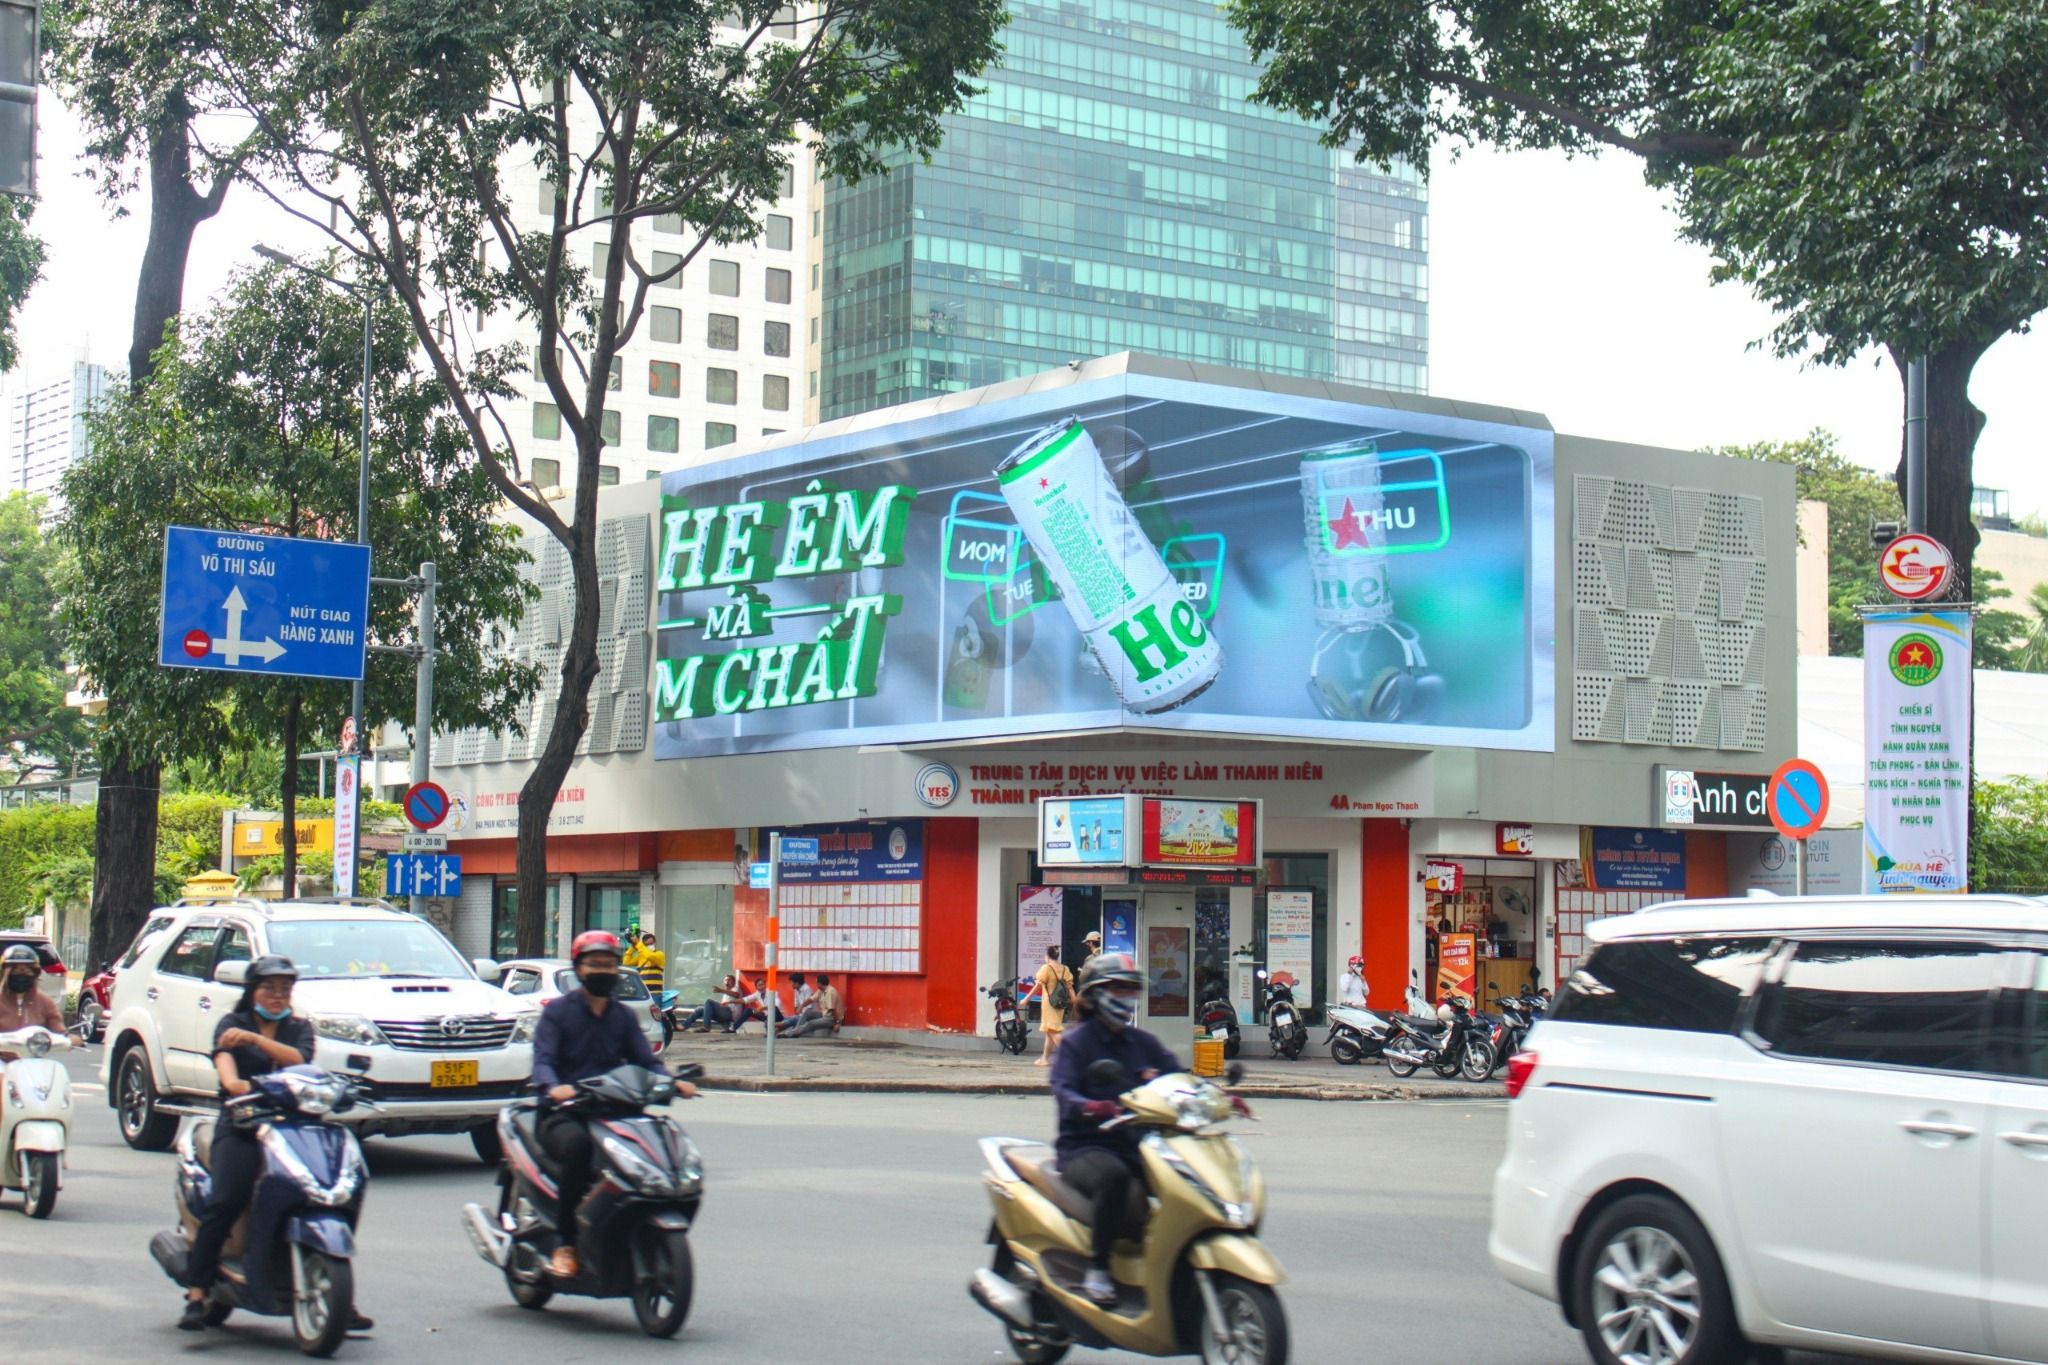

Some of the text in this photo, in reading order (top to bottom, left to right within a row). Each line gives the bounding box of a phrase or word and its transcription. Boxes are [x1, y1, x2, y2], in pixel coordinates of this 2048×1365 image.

[775, 479, 913, 577] ÊM
[1351, 506, 1416, 532] THU
[217, 536, 265, 552] ĐƯỜNG
[201, 553, 276, 577] VÕ THỊ SÁU
[1003, 578, 1034, 604] TUE
[1178, 582, 1208, 600] ED
[290, 605, 351, 623] NÚT GIAO
[280, 622, 355, 646] HÀNG XANH
[1108, 599, 1207, 684] He
[713, 592, 895, 714] CHẤT
[1899, 702, 1922, 716] CHIẾN
[1910, 723, 1941, 734] NGUYỆN
[1928, 742, 1950, 751] XANH
[970, 760, 1323, 786] TRUNG TÂM DỊCH VỤ VIỆC LÀM THANH NIÊN
[1889, 761, 1914, 770] PHONG
[928, 786, 950, 797] YES
[970, 783, 1024, 804] THÀNH
[1691, 780, 1737, 814] Anh
[1330, 794, 1350, 810] 4A
[1667, 808, 1693, 817] MOGIN
[1186, 842, 1212, 855] 2022
[1789, 840, 1830, 852] MGIN
[445, 1062, 464, 1073] 51F
